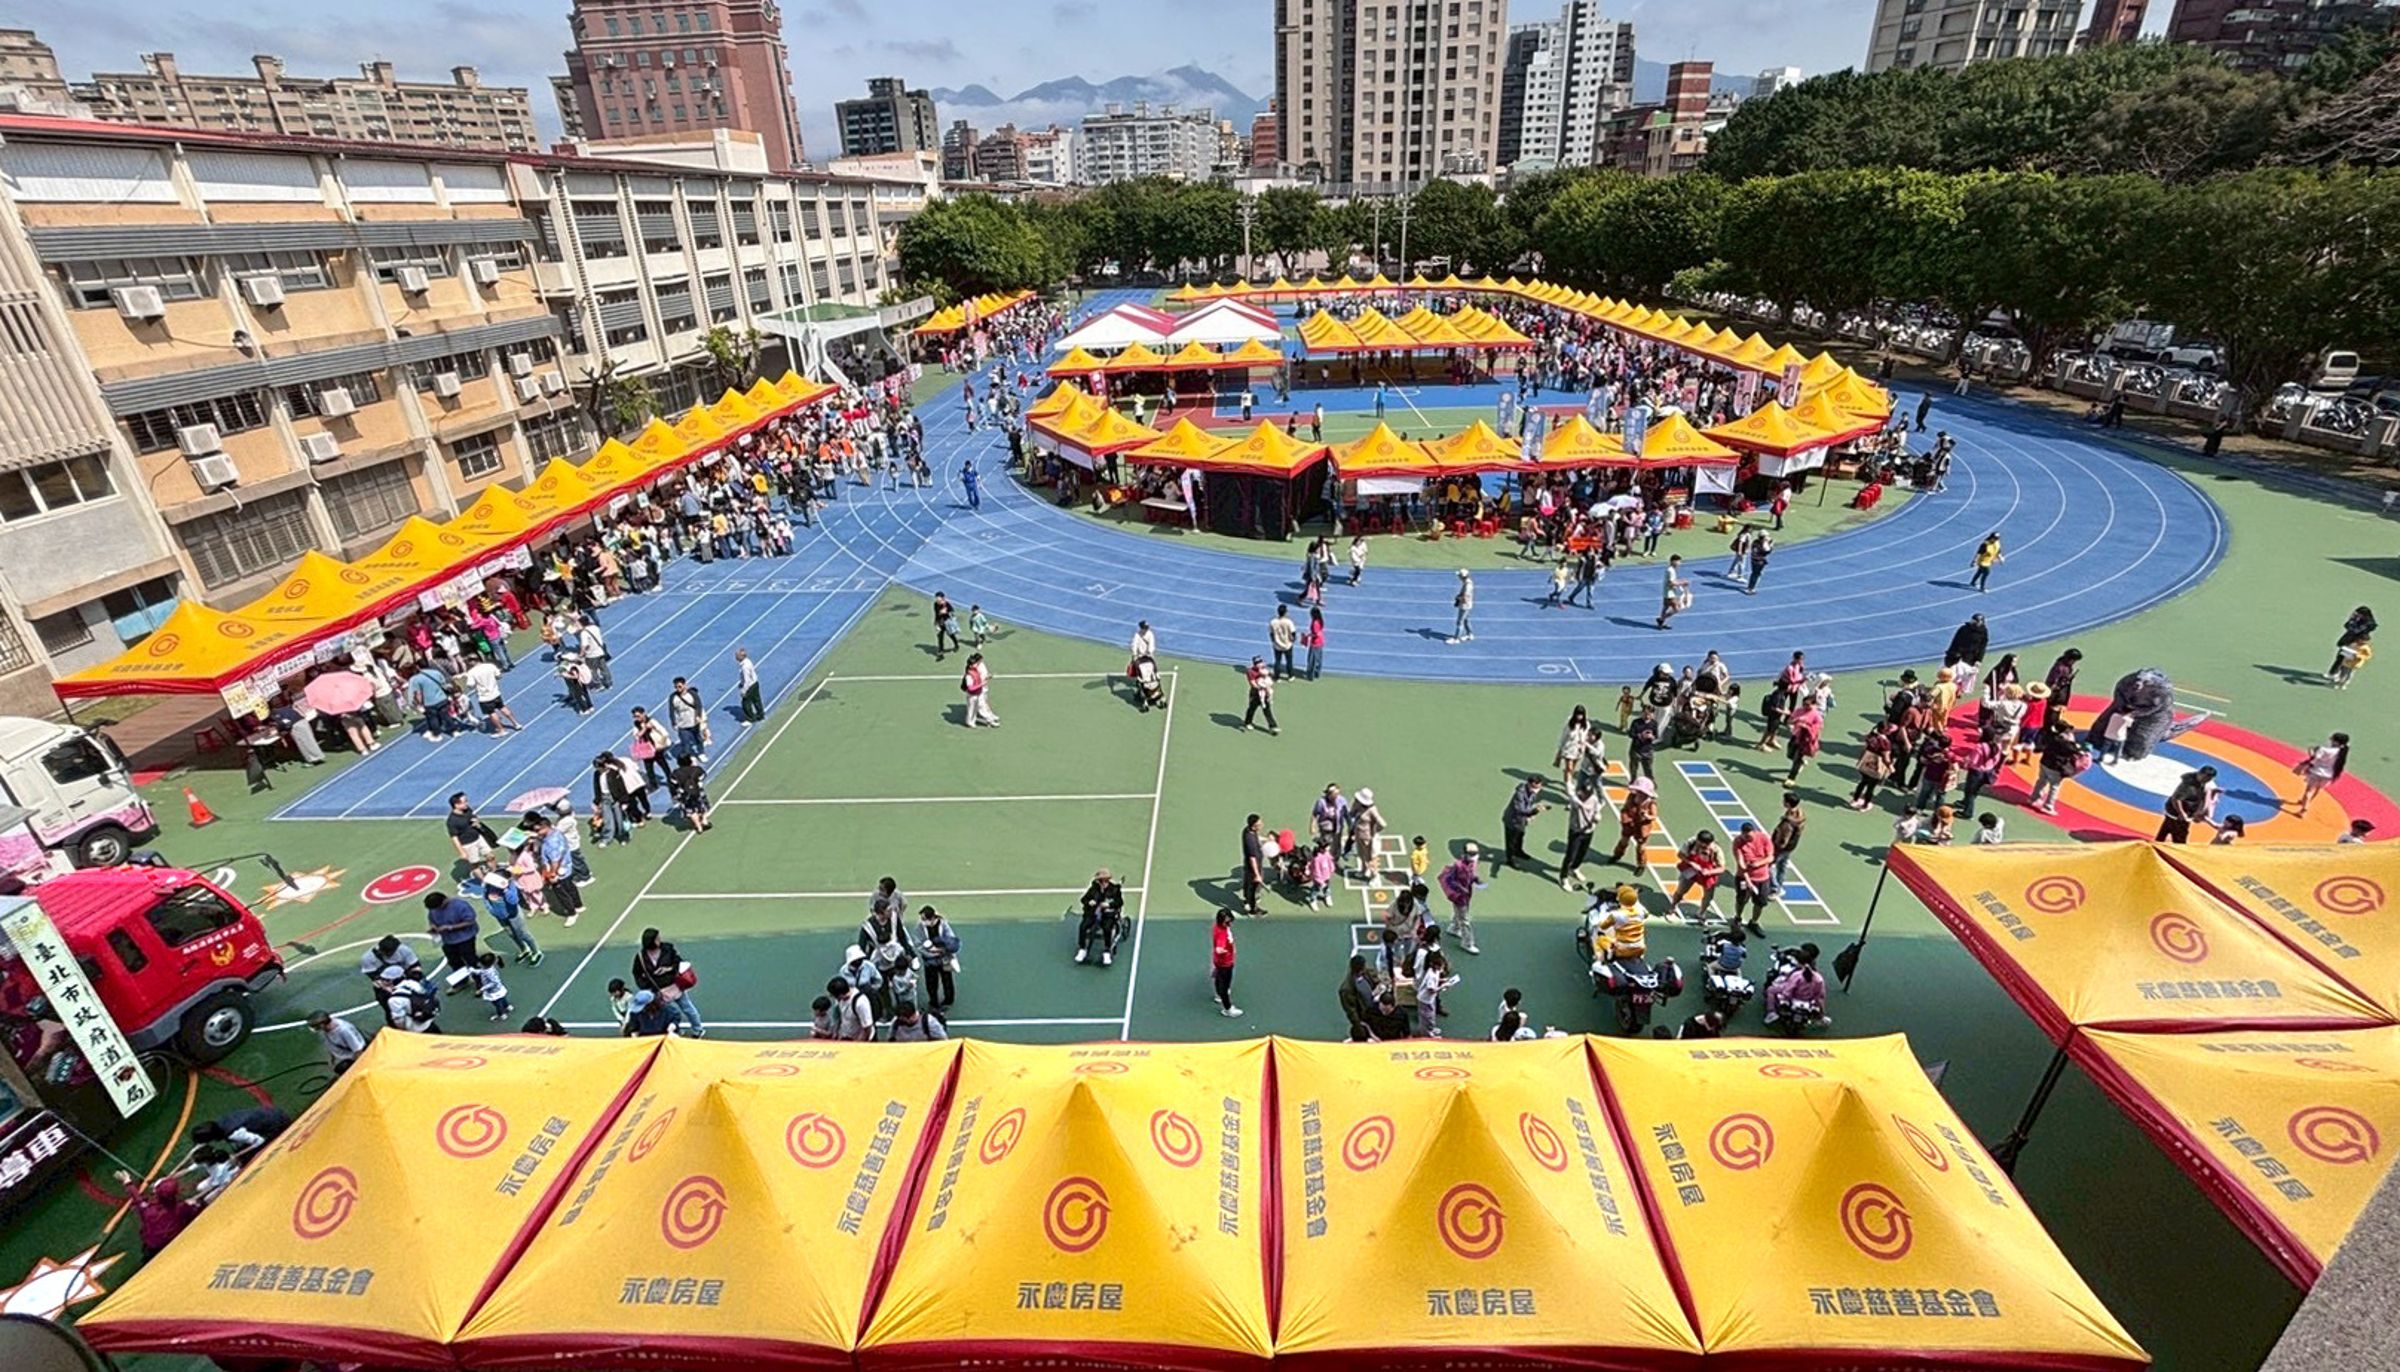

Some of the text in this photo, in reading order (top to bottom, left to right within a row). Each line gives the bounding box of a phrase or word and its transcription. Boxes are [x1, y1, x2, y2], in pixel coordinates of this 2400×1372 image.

[2136, 979, 2283, 1001] 永慶慈善基金會
[496, 1116, 571, 1197] 永慶房屋
[836, 1100, 907, 1236] 永慶慈善基金會
[1216, 1096, 1242, 1236] 永慶慈善基金會
[1300, 1100, 1328, 1239] 永慶慈善基金會
[1651, 1123, 1706, 1208] 永慶房屋
[2209, 1116, 2314, 1202] 永慶房屋
[207, 1262, 374, 1297] 永慶慈善基金會
[619, 1276, 726, 1307] 永慶房屋
[1016, 1281, 1124, 1312] 永慶房屋
[1426, 1286, 1537, 1318] 永慶房屋
[1809, 1286, 2002, 1319] 永慶慈善基金會
